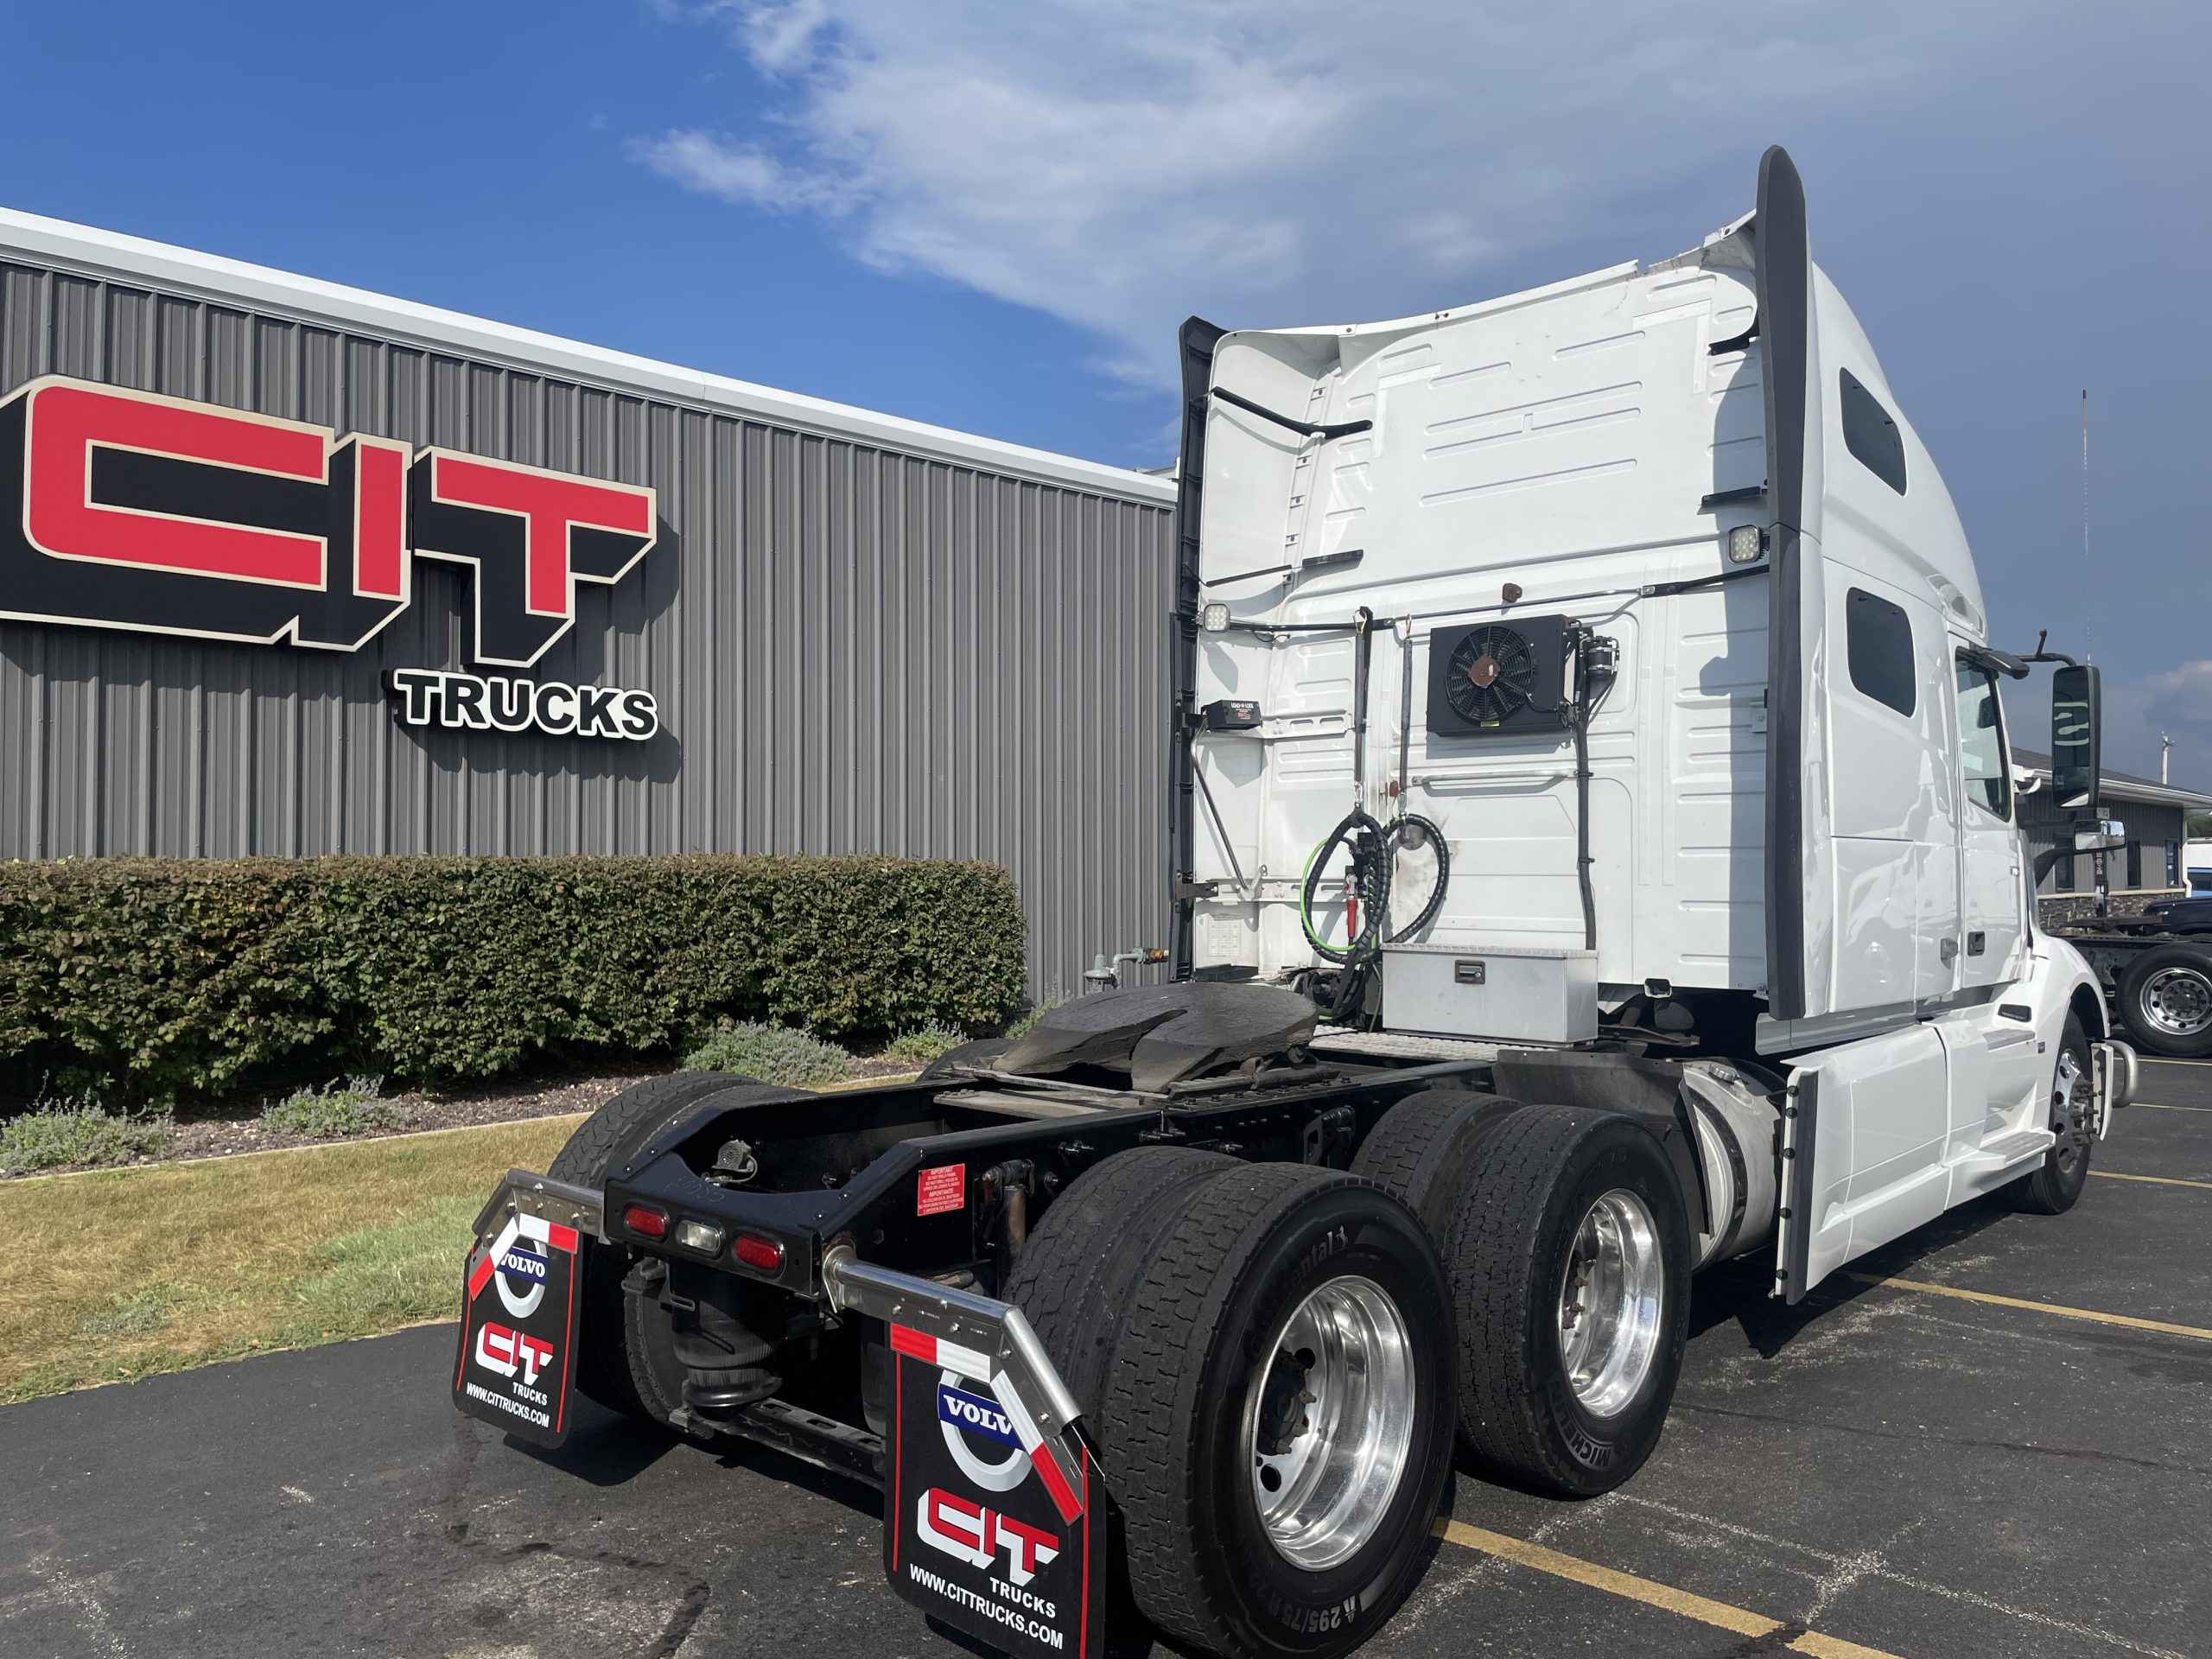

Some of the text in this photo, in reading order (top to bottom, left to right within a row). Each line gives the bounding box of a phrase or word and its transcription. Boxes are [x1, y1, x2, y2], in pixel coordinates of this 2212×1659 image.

[23, 375, 657, 618] CIT
[393, 669, 658, 741] TRUCKS
[929, 1188, 954, 1197] IMPORTANTE
[931, 1166, 953, 1175] IMPORTANT
[476, 1321, 554, 1385] CIT
[467, 1382, 550, 1428] WWW.CITTRUCKS.COM
[513, 1382, 548, 1406] TRUCKS
[944, 1395, 1012, 1435] VOLV
[918, 1487, 1059, 1586] CIT
[910, 1564, 1063, 1649] WWW.CITTRUCKS.COM
[990, 1577, 1057, 1618] TRUCKS
